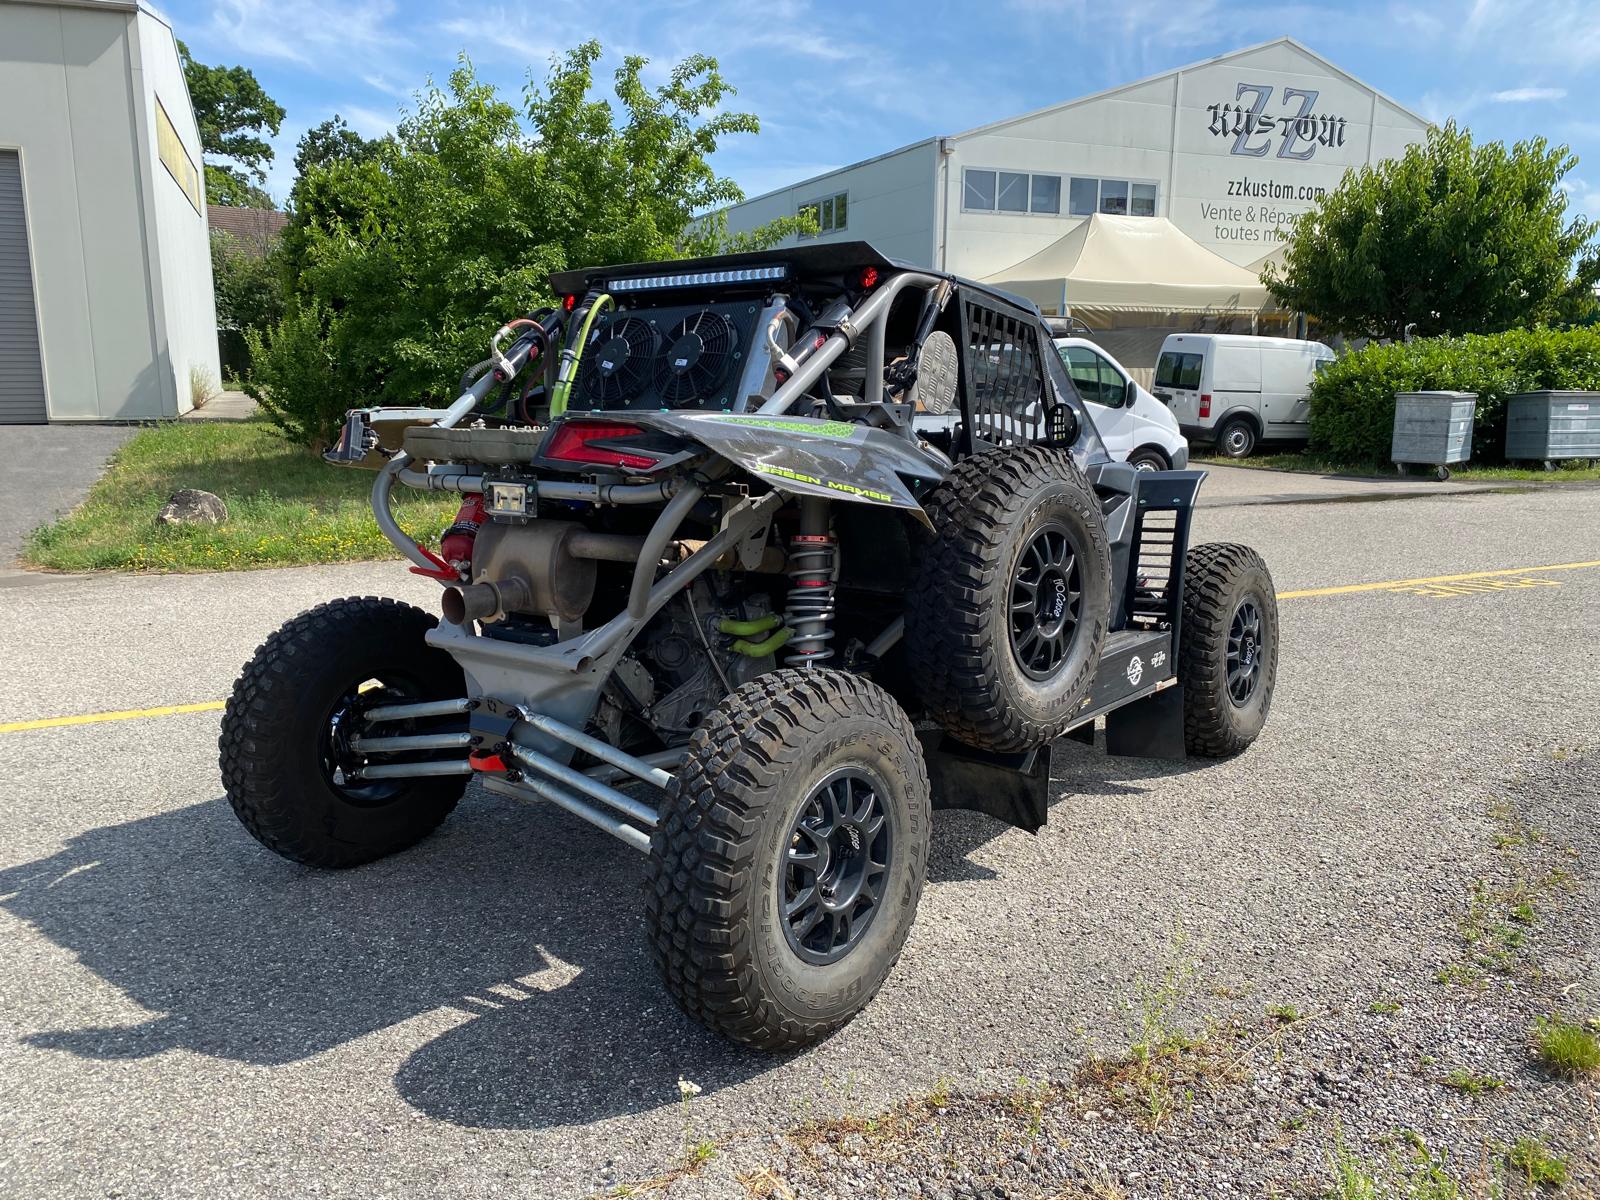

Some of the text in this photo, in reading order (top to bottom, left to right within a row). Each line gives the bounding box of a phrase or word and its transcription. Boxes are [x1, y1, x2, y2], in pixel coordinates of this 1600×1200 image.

[1201, 203, 1242, 222] Vente
[1245, 206, 1257, 222] &
[1215, 224, 1259, 242] toutes
[828, 480, 893, 502] MAMBA
